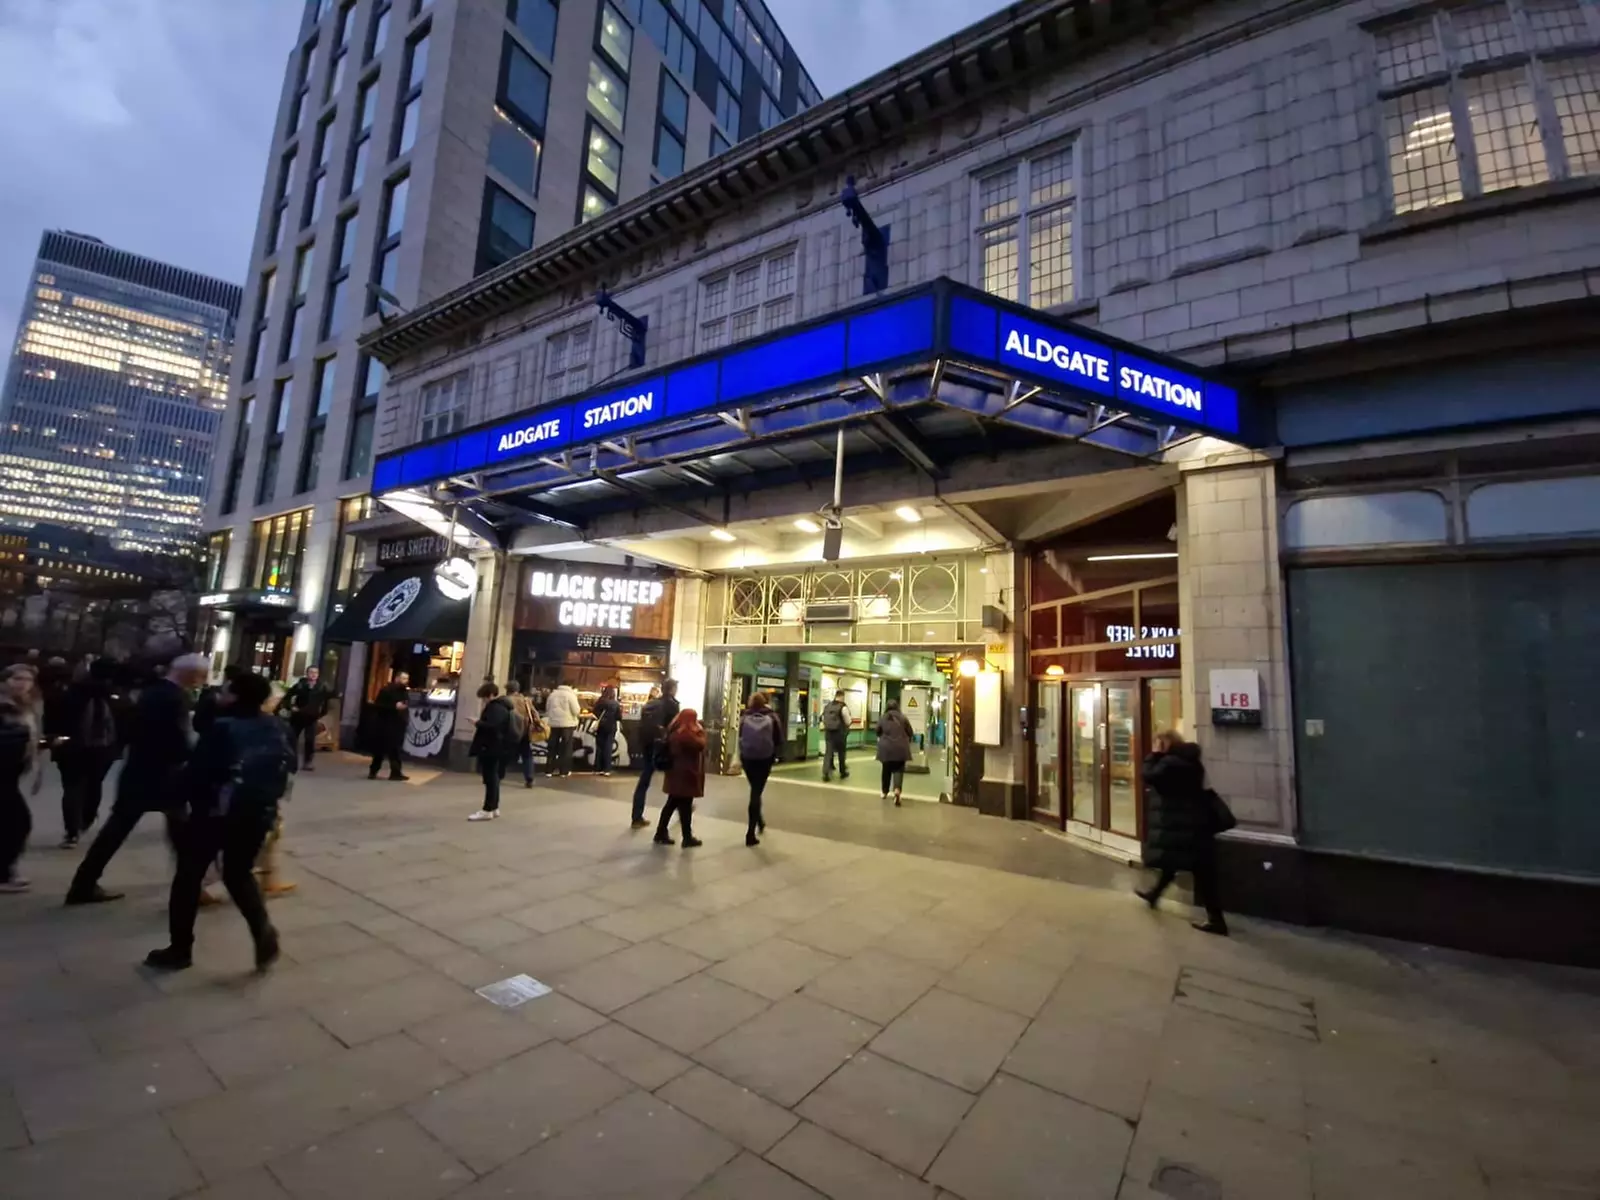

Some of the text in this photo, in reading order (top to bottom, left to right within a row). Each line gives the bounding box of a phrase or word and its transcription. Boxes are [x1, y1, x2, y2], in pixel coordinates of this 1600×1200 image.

[1004, 330, 1202, 411] ALDGATE STATION
[498, 391, 653, 451] ALDGATE STATION
[530, 571, 664, 605] BLACK SHEEP
[558, 601, 633, 630] COFFEE
[1220, 692, 1249, 708] LFB
